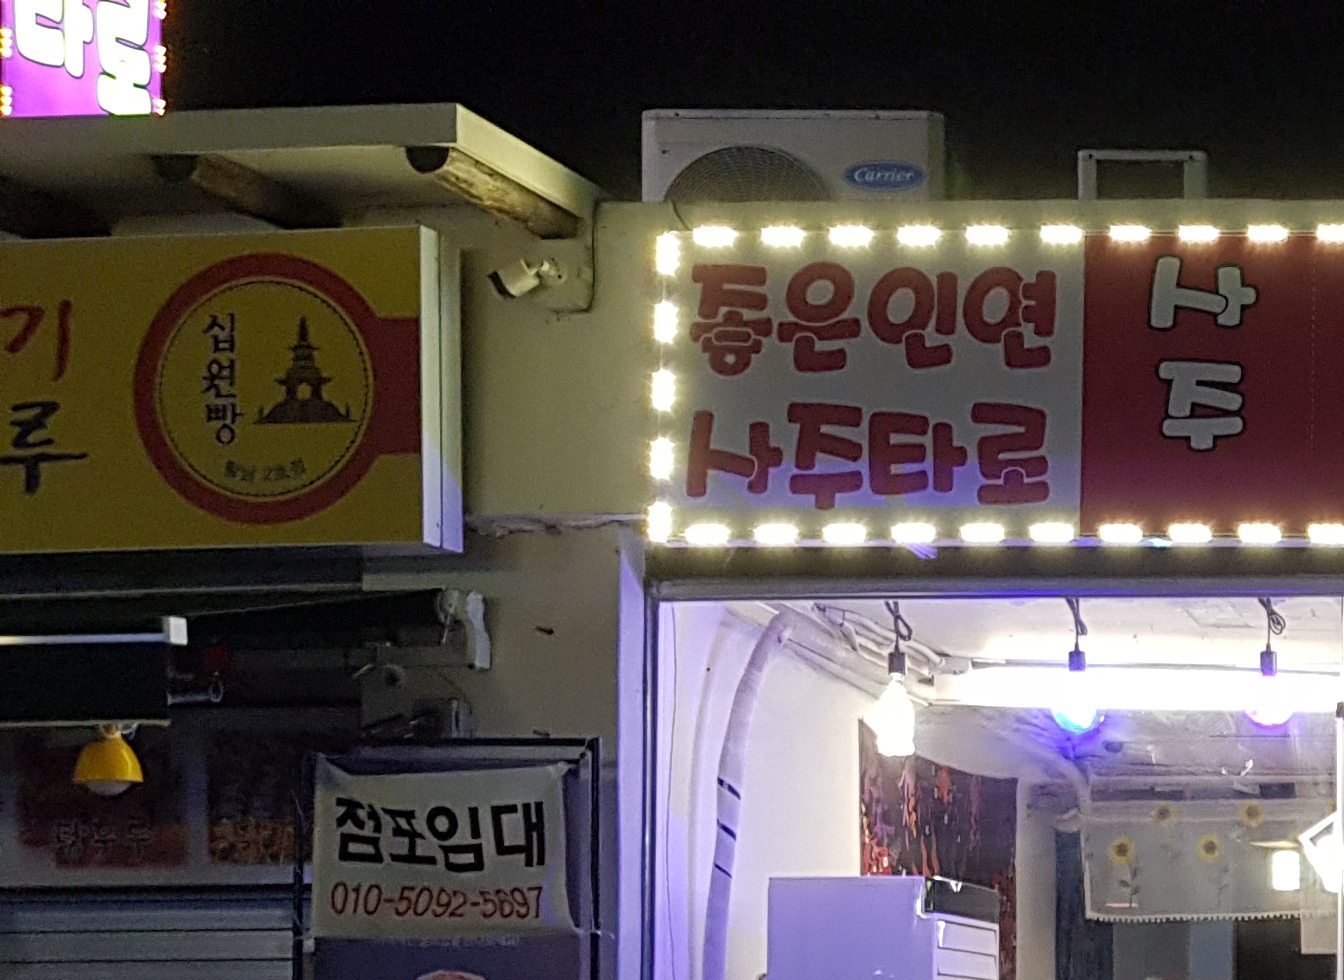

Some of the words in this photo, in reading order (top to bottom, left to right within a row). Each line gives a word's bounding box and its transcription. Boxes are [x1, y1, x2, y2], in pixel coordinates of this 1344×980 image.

[854, 166, 914, 182] Carrier
[690, 262, 1056, 376] 좋은인연
[1148, 254, 1257, 452] 사주
[202, 312, 244, 446] 십원빵
[686, 403, 1050, 510] 사주타로
[335, 797, 546, 873] 점포임대
